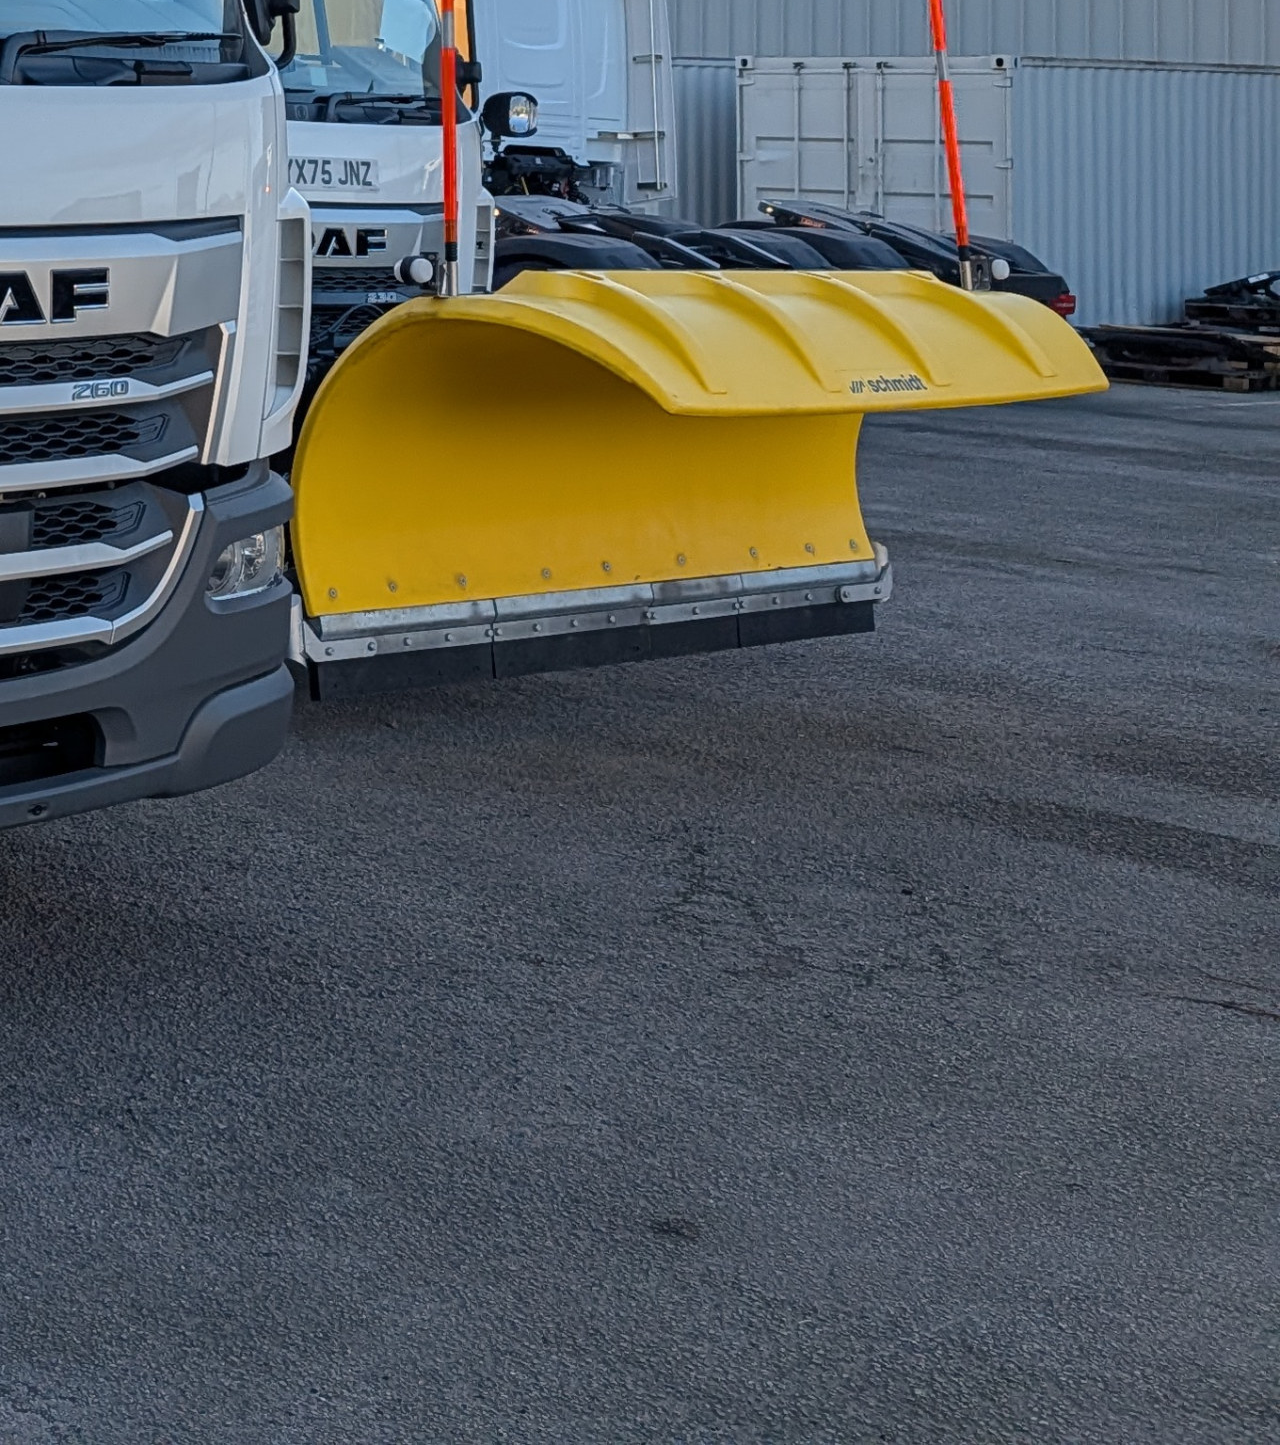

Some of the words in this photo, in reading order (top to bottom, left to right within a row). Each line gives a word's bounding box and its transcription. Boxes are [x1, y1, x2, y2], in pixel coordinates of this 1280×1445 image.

[338, 160, 373, 187] JNZ
[312, 227, 387, 258] AF
[71, 380, 129, 401] 260
[867, 374, 928, 393] schmidt
